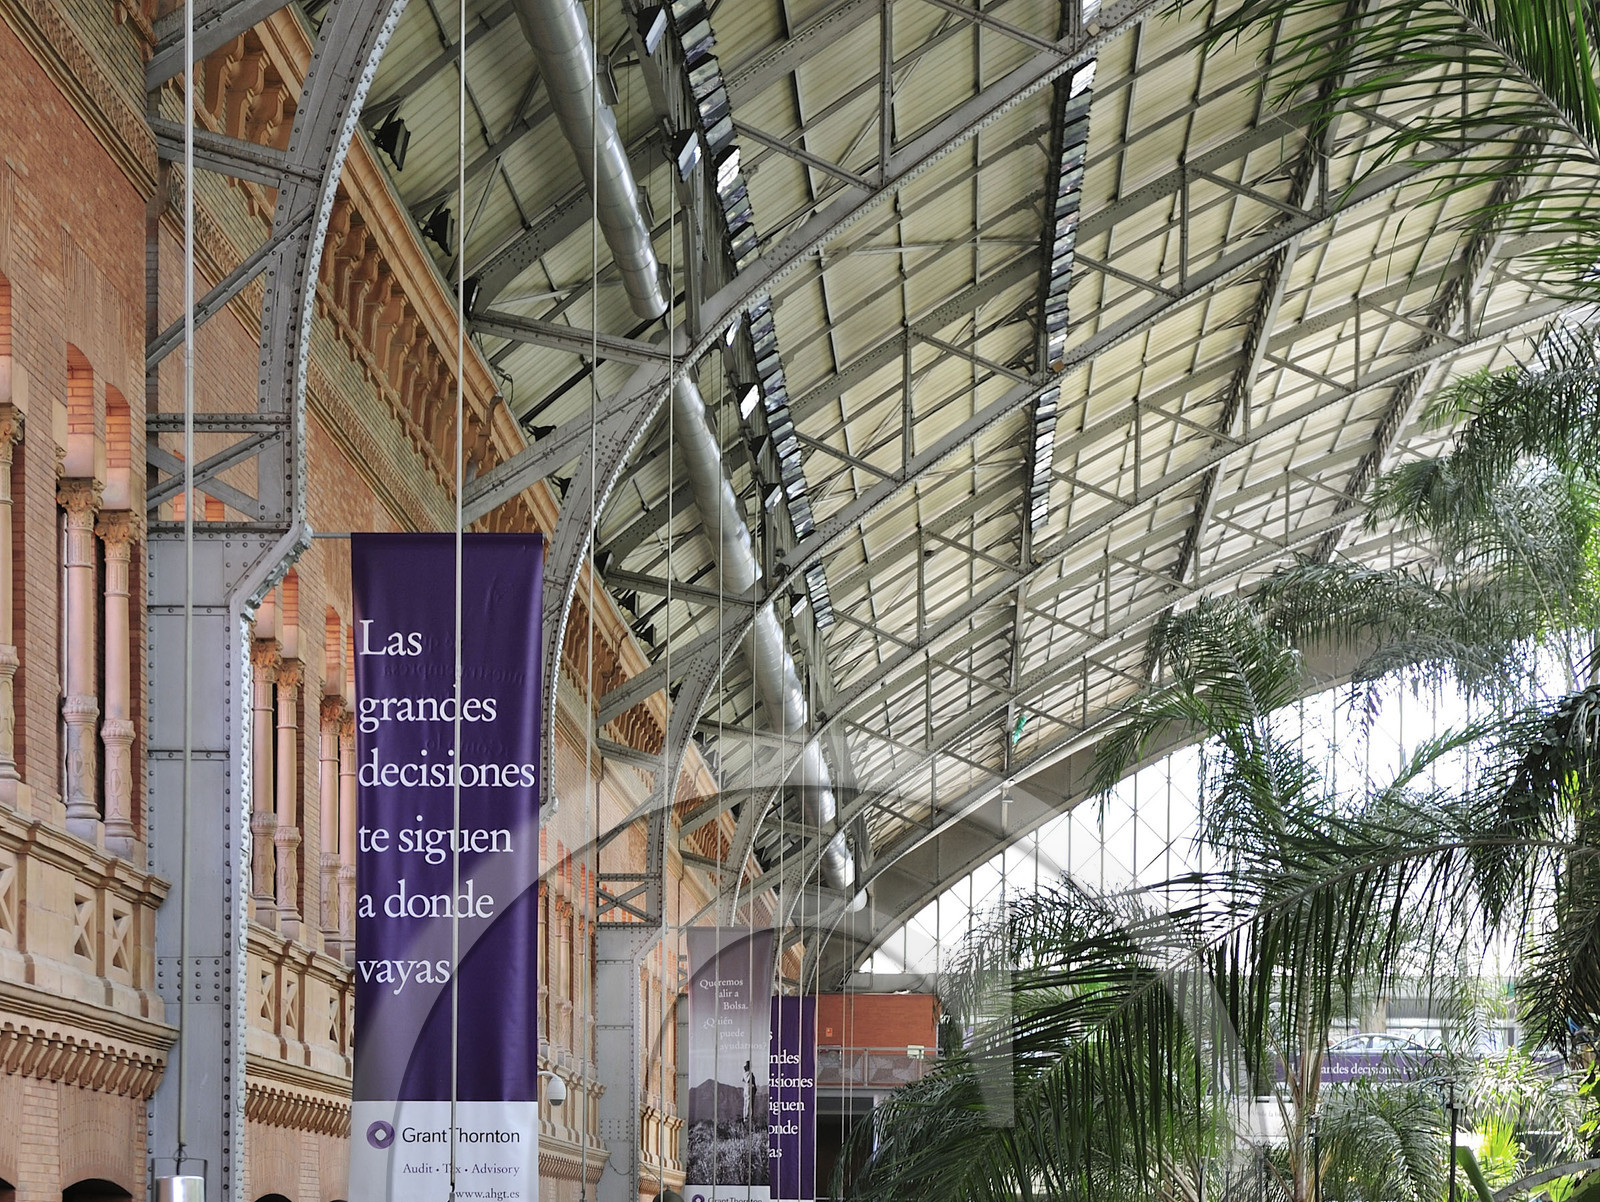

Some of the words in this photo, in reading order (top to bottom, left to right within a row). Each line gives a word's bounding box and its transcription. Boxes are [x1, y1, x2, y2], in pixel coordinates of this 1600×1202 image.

[359, 619, 422, 656] Las
[359, 683, 497, 733] grandes
[358, 747, 535, 788] decisiones
[358, 825, 390, 853] te
[398, 814, 514, 865] siguen
[358, 894, 376, 919] a
[383, 878, 495, 919] donde
[357, 959, 451, 995] vayas
[402, 1127, 448, 1143] Grant
[402, 1163, 433, 1174] Audit
[442, 1163, 461, 1174] Tx
[471, 1163, 520, 1177] Advisory
[454, 1187, 520, 1201] www.ahgt.es
